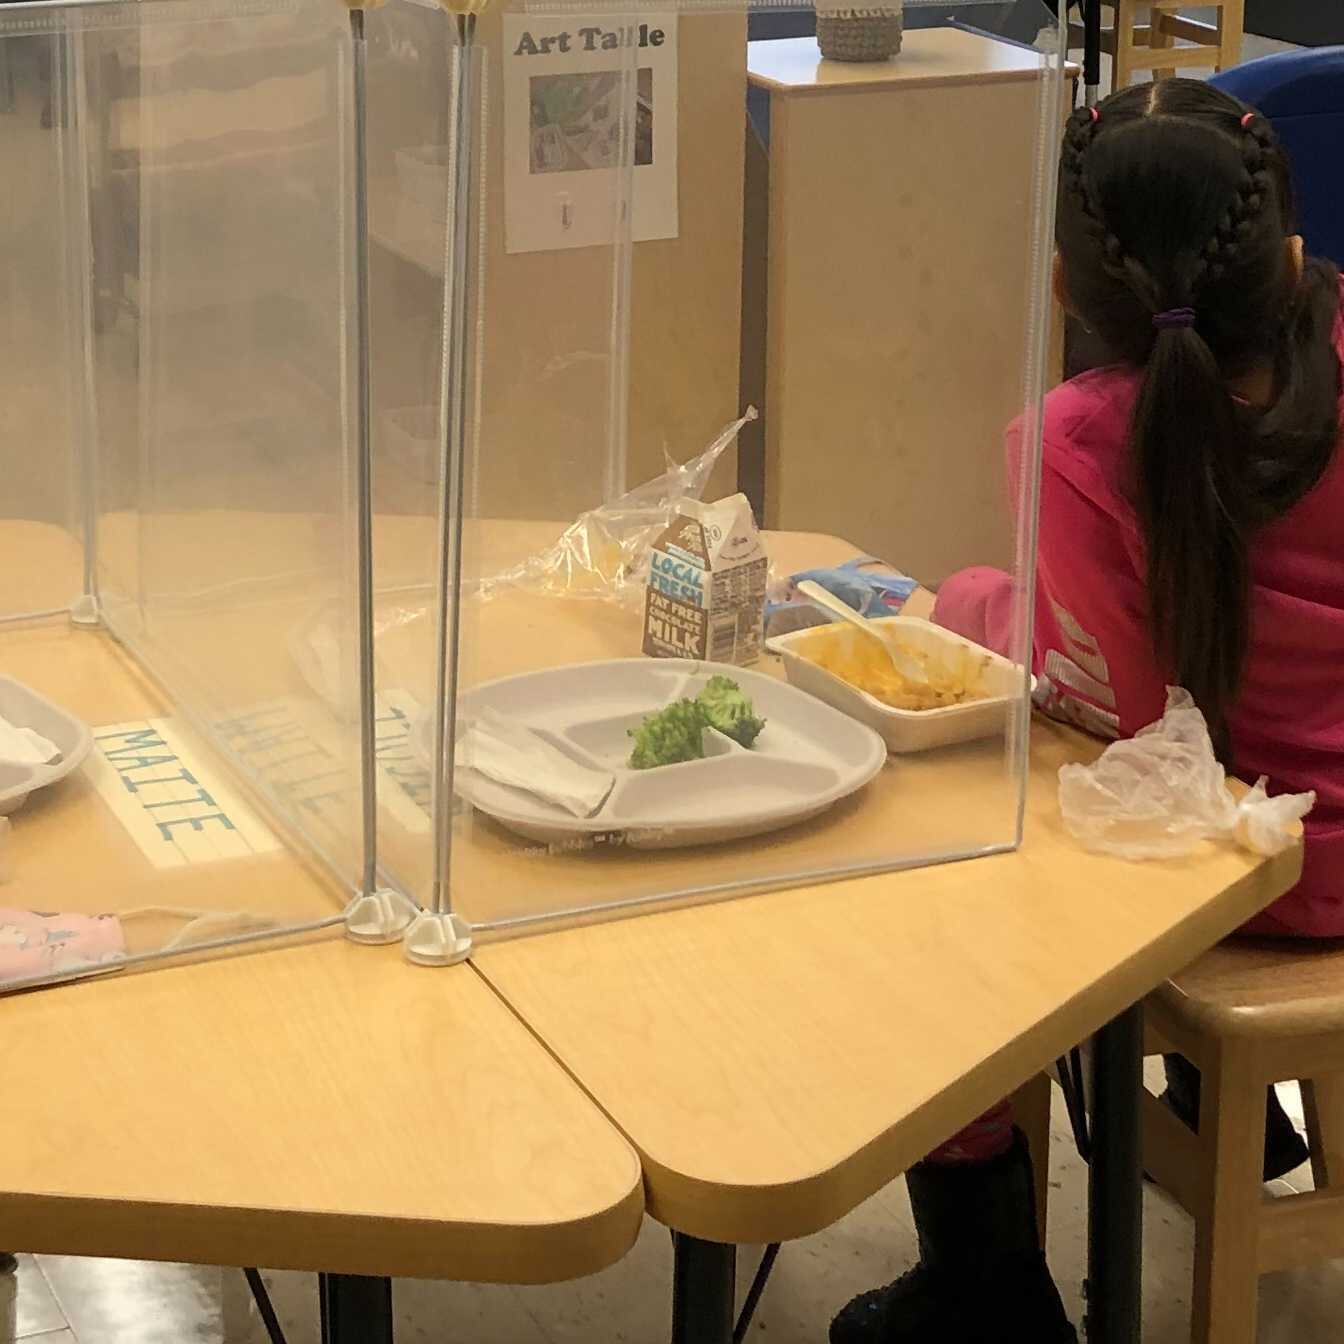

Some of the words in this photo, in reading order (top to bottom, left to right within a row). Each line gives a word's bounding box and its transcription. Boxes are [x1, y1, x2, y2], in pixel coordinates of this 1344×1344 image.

[513, 31, 572, 56] Art
[651, 551, 703, 589] LOCAL
[649, 592, 670, 609] FAT
[672, 600, 703, 624] FREE
[648, 615, 701, 655] MILK
[94, 727, 236, 842] MAITE
